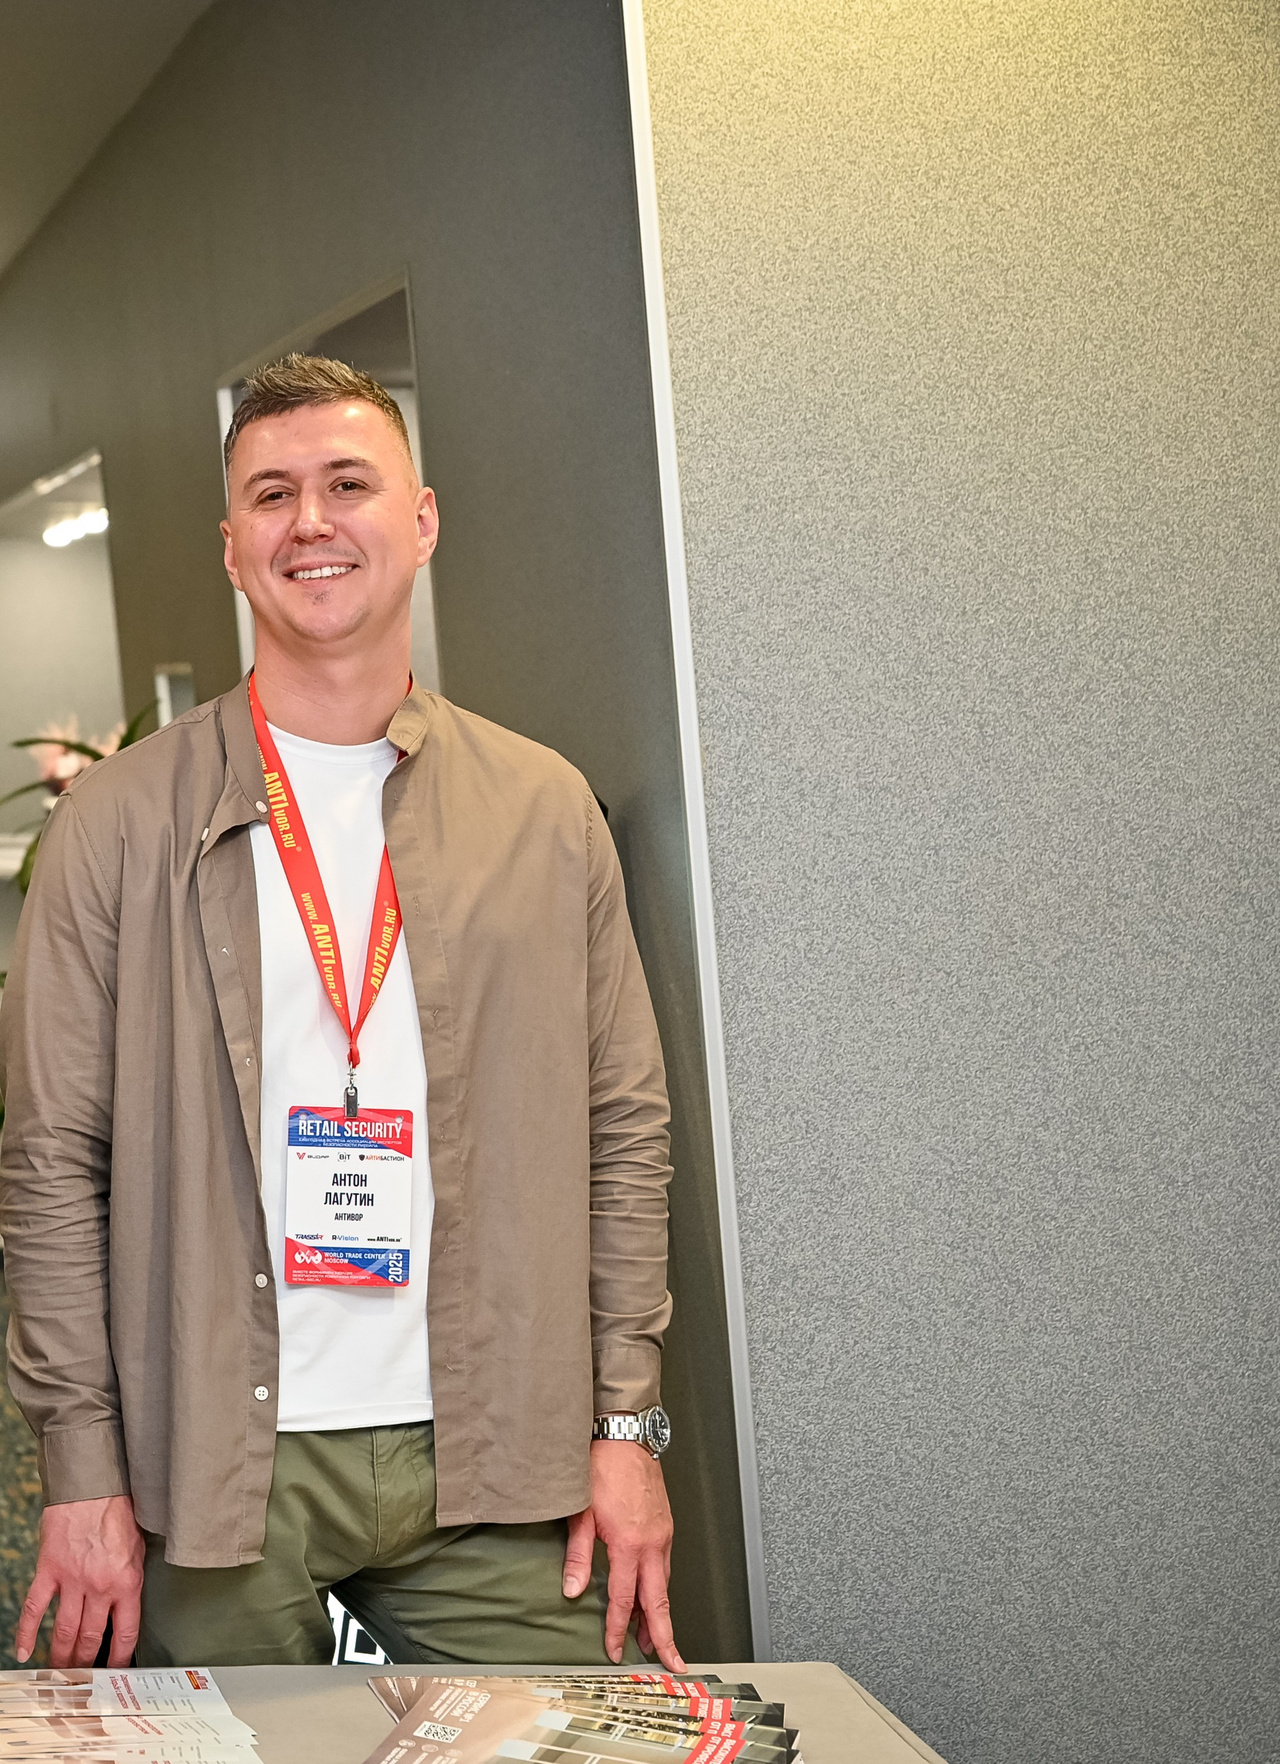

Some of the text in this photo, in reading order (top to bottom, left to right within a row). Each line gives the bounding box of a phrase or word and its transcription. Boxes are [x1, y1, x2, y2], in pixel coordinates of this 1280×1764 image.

[298, 1119, 403, 1139] RETAIL SECURITY
[331, 1173, 368, 1187] АНТОН
[323, 1192, 375, 1207] ЛАГУТИН
[334, 1212, 364, 1222] АНТИВОР
[388, 1252, 403, 1283] 2025
